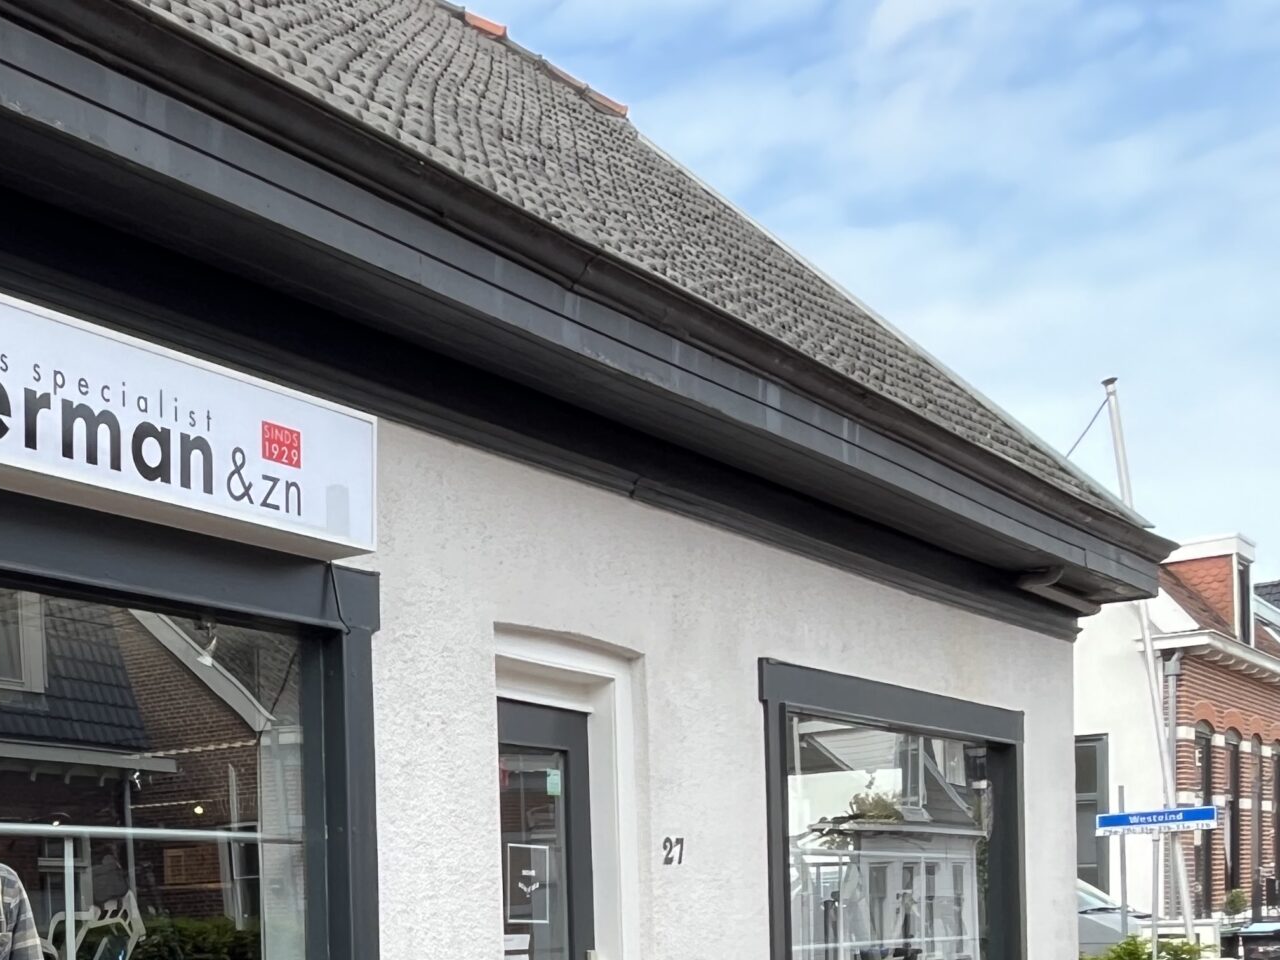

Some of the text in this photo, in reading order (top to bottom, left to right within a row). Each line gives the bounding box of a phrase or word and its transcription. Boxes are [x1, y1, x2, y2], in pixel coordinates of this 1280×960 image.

[32, 362, 213, 432] specialist
[263, 424, 299, 447] SINDS
[264, 440, 299, 465] 1929
[662, 836, 684, 865] 27
